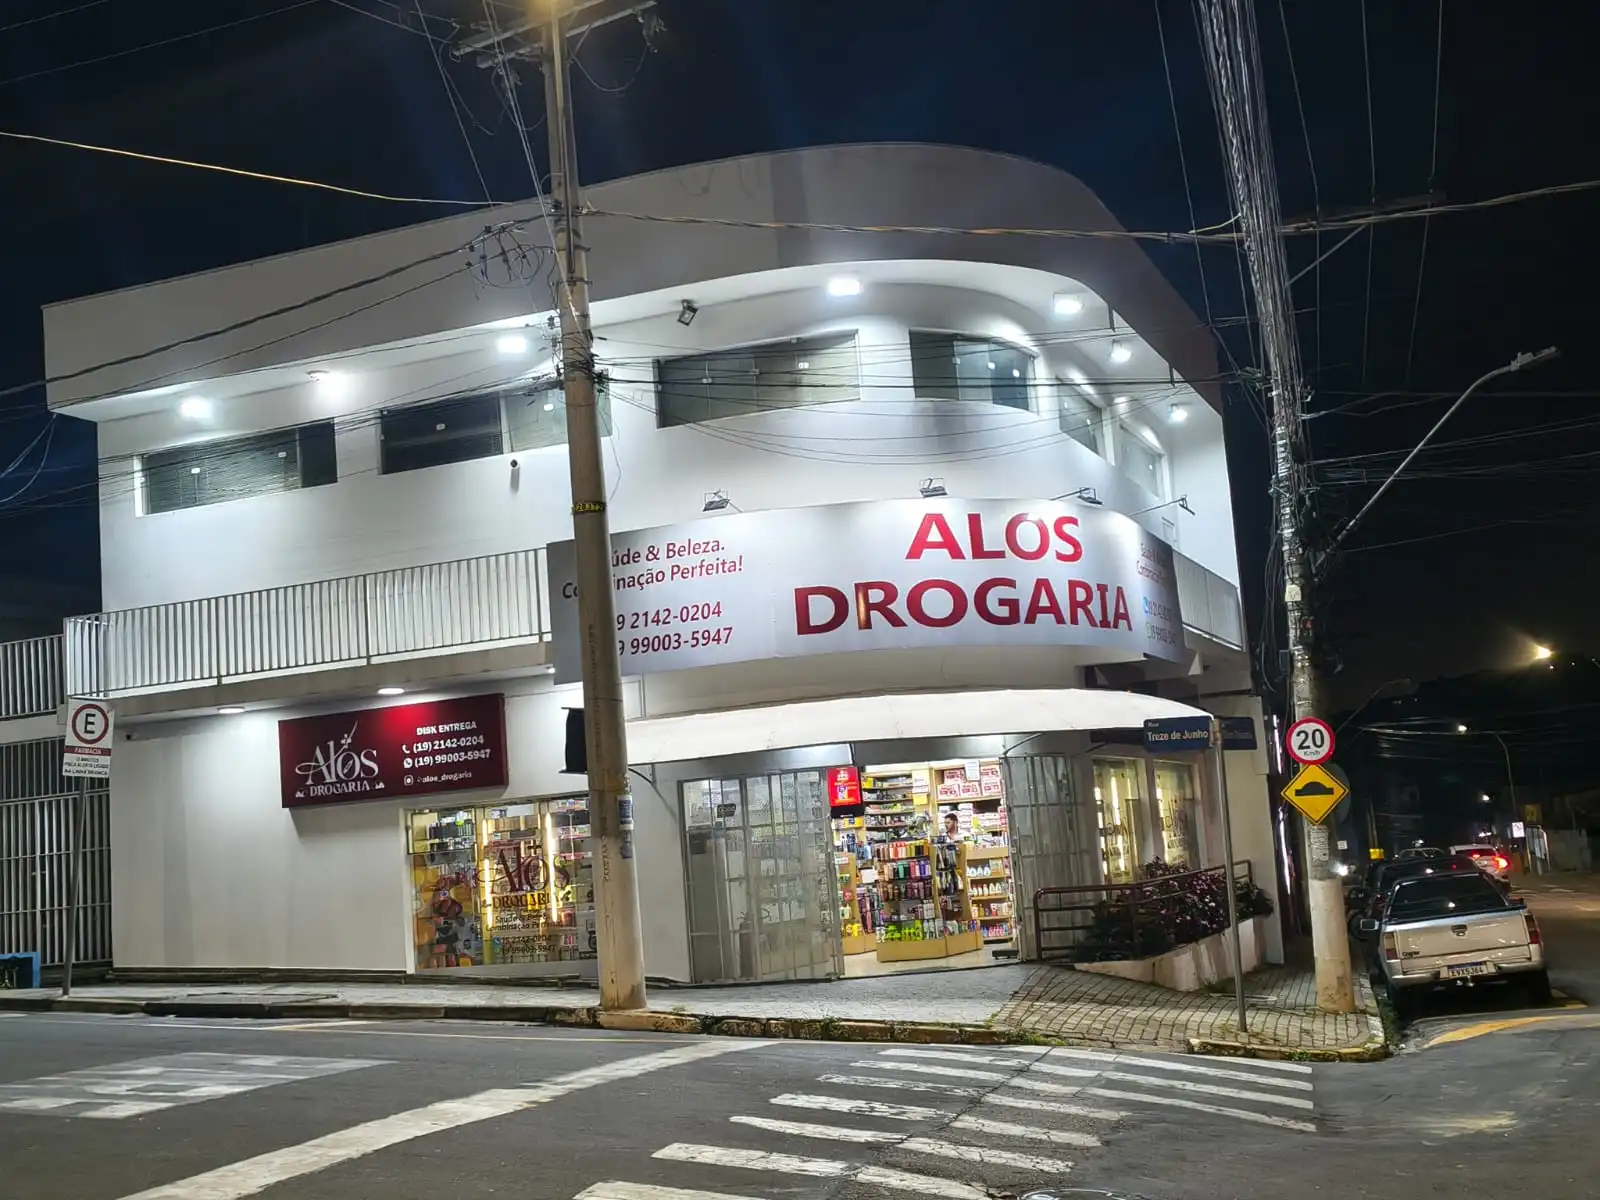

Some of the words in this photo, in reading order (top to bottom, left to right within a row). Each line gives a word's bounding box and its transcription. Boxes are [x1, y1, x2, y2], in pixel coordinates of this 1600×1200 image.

[905, 512, 1083, 563] ALOS
[612, 546, 641, 567] úde
[645, 545, 660, 562] &
[665, 537, 726, 559] Beleza.
[670, 555, 744, 582] Perfeita!
[630, 601, 722, 629] 2142-0204
[793, 577, 1134, 636] DROGARIA
[630, 626, 734, 656] 99003-5947
[84, 713, 96, 734] E
[416, 726, 437, 736] DISK
[438, 720, 477, 733] ENTREGA
[1170, 730, 1182, 740] de
[1183, 729, 1209, 740] Junho
[412, 741, 432, 754] (19)
[433, 735, 485, 750] 2142-0204
[1296, 728, 1325, 750] 20
[414, 756, 434, 768] (19)
[434, 748, 491, 765] 99003-5947
[309, 780, 370, 797] DROGARIA
